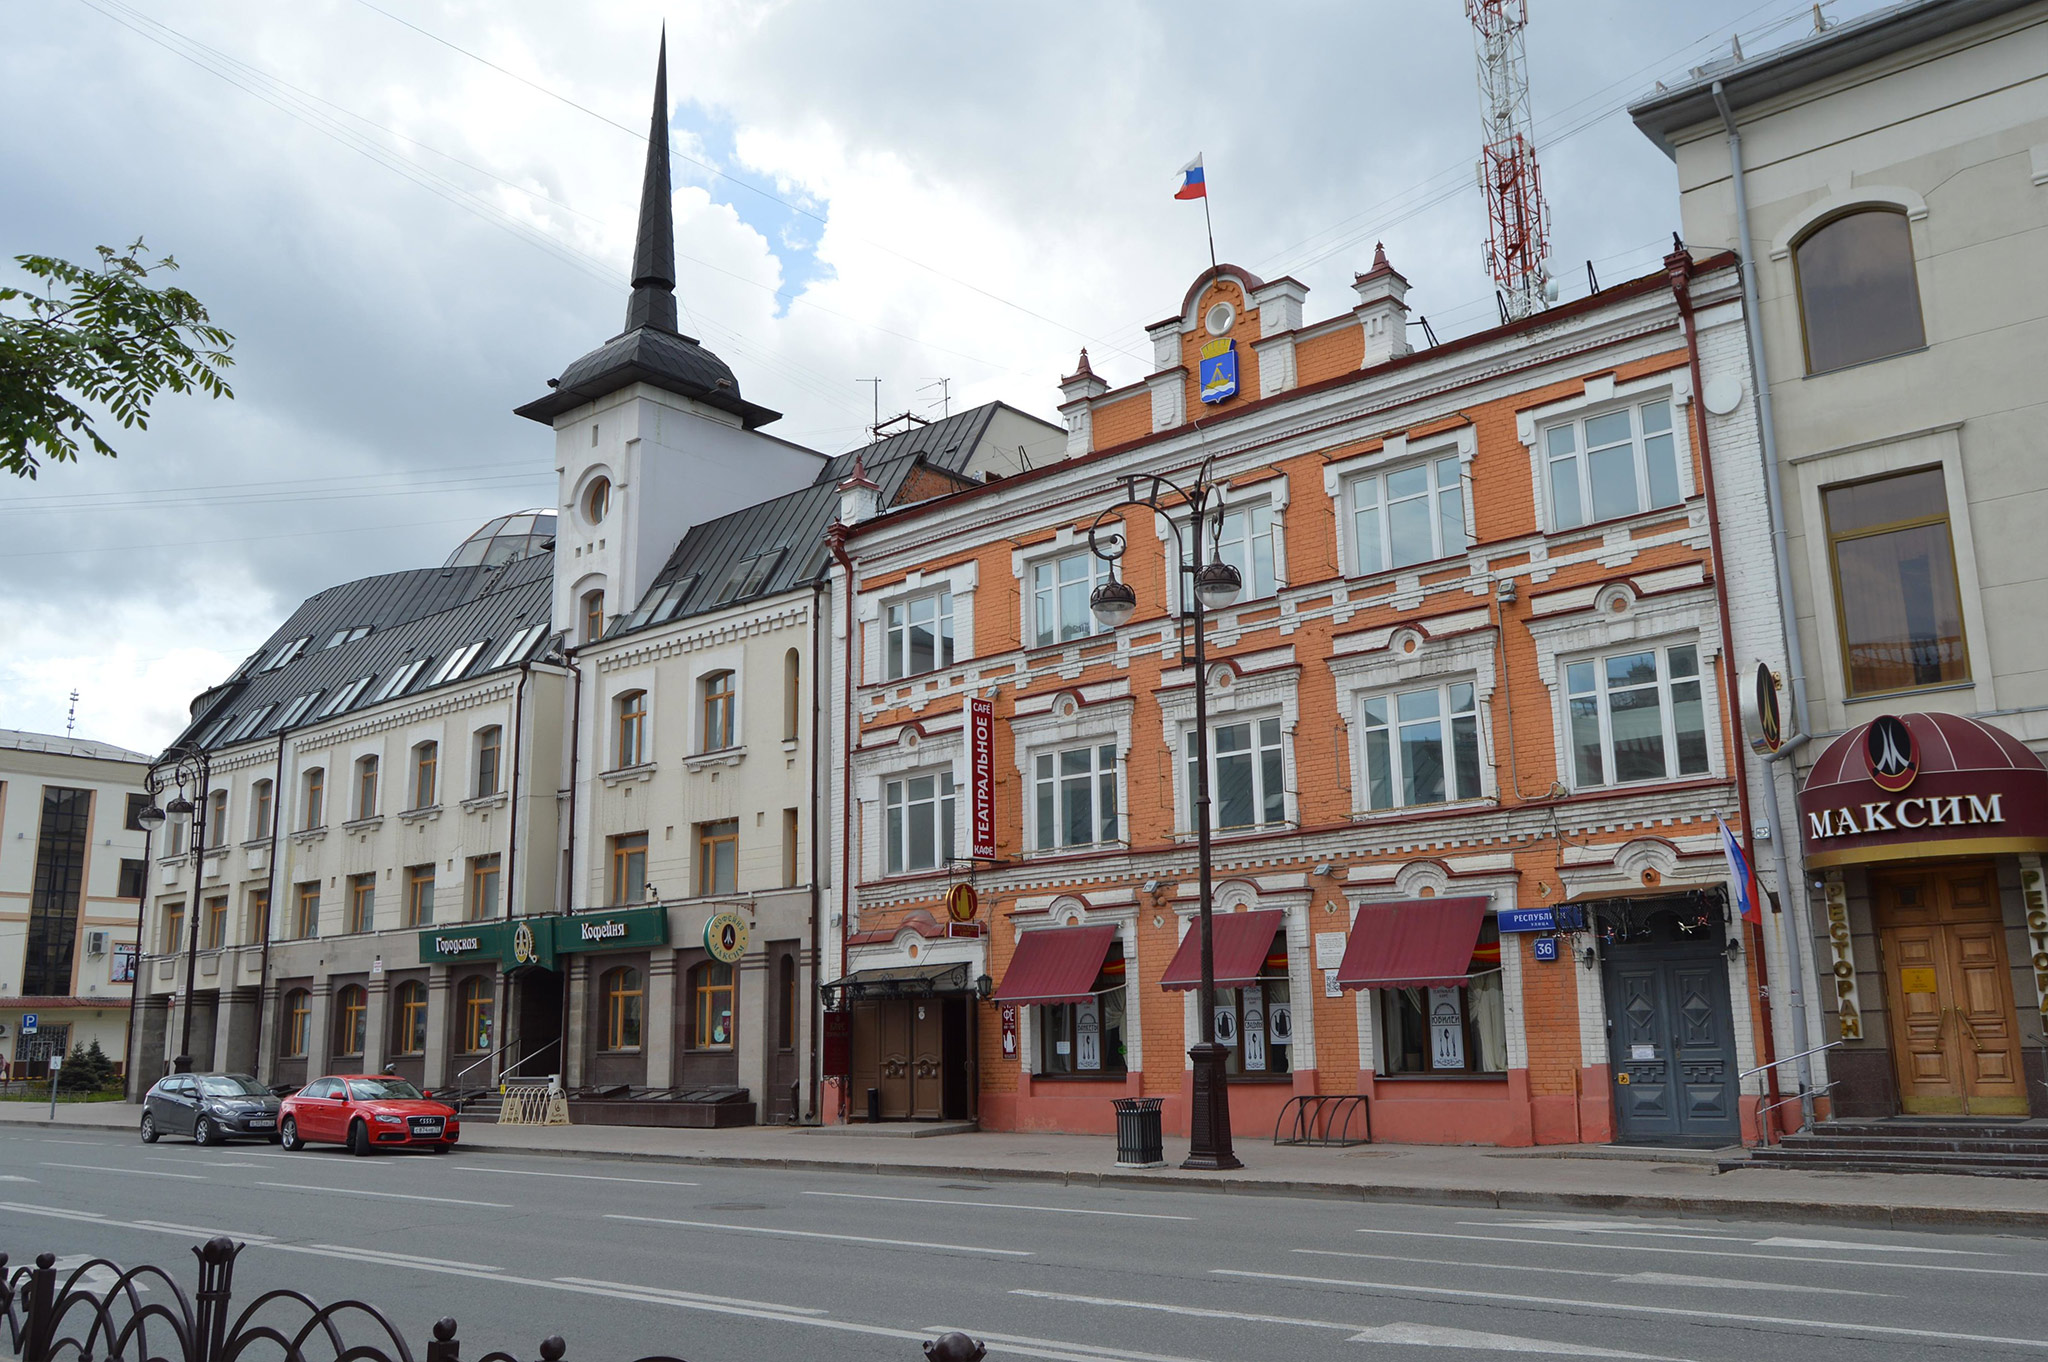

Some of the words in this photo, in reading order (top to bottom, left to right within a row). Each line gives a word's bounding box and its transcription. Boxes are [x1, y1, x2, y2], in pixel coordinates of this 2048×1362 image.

[973, 701, 991, 715] CAFÉ
[976, 716, 989, 842] ТЕАТРАЛЬНОЕ
[1808, 793, 2006, 840] МАКСИМ
[974, 845, 994, 856] КАФЕ
[581, 920, 625, 941] Кофейня
[435, 936, 478, 954] Городская
[713, 943, 745, 960] МАКСИМ
[1537, 943, 1552, 955] 36
[1826, 884, 1860, 1038] РЕСТОРАН
